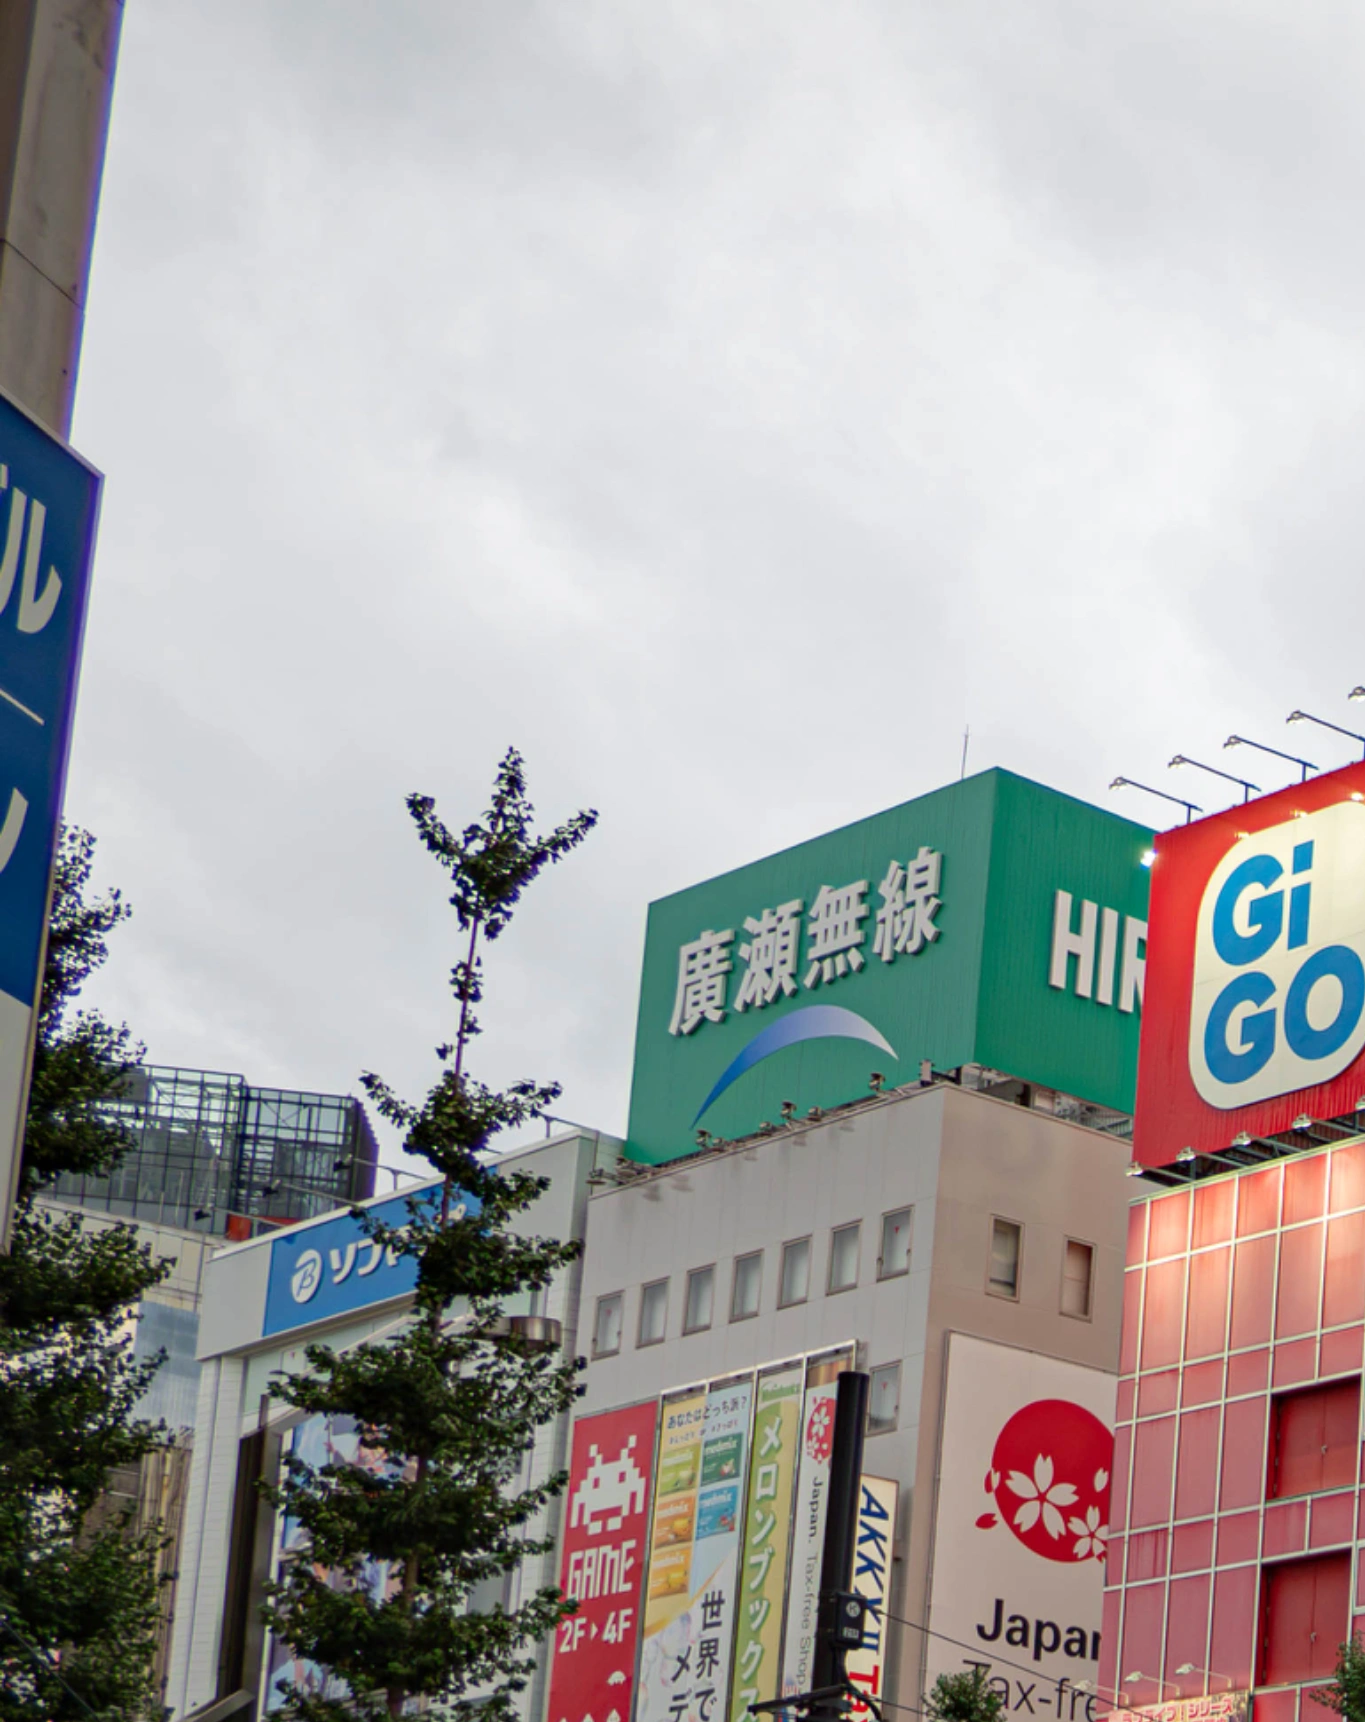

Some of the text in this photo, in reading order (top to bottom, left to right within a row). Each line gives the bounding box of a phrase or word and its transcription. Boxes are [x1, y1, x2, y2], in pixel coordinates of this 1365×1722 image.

[668, 845, 945, 1038] 廣瀬無線
[807, 1476, 823, 1545] Japan.
[568, 1540, 638, 1600] GAME
[559, 1610, 634, 1654] 2F 4F
